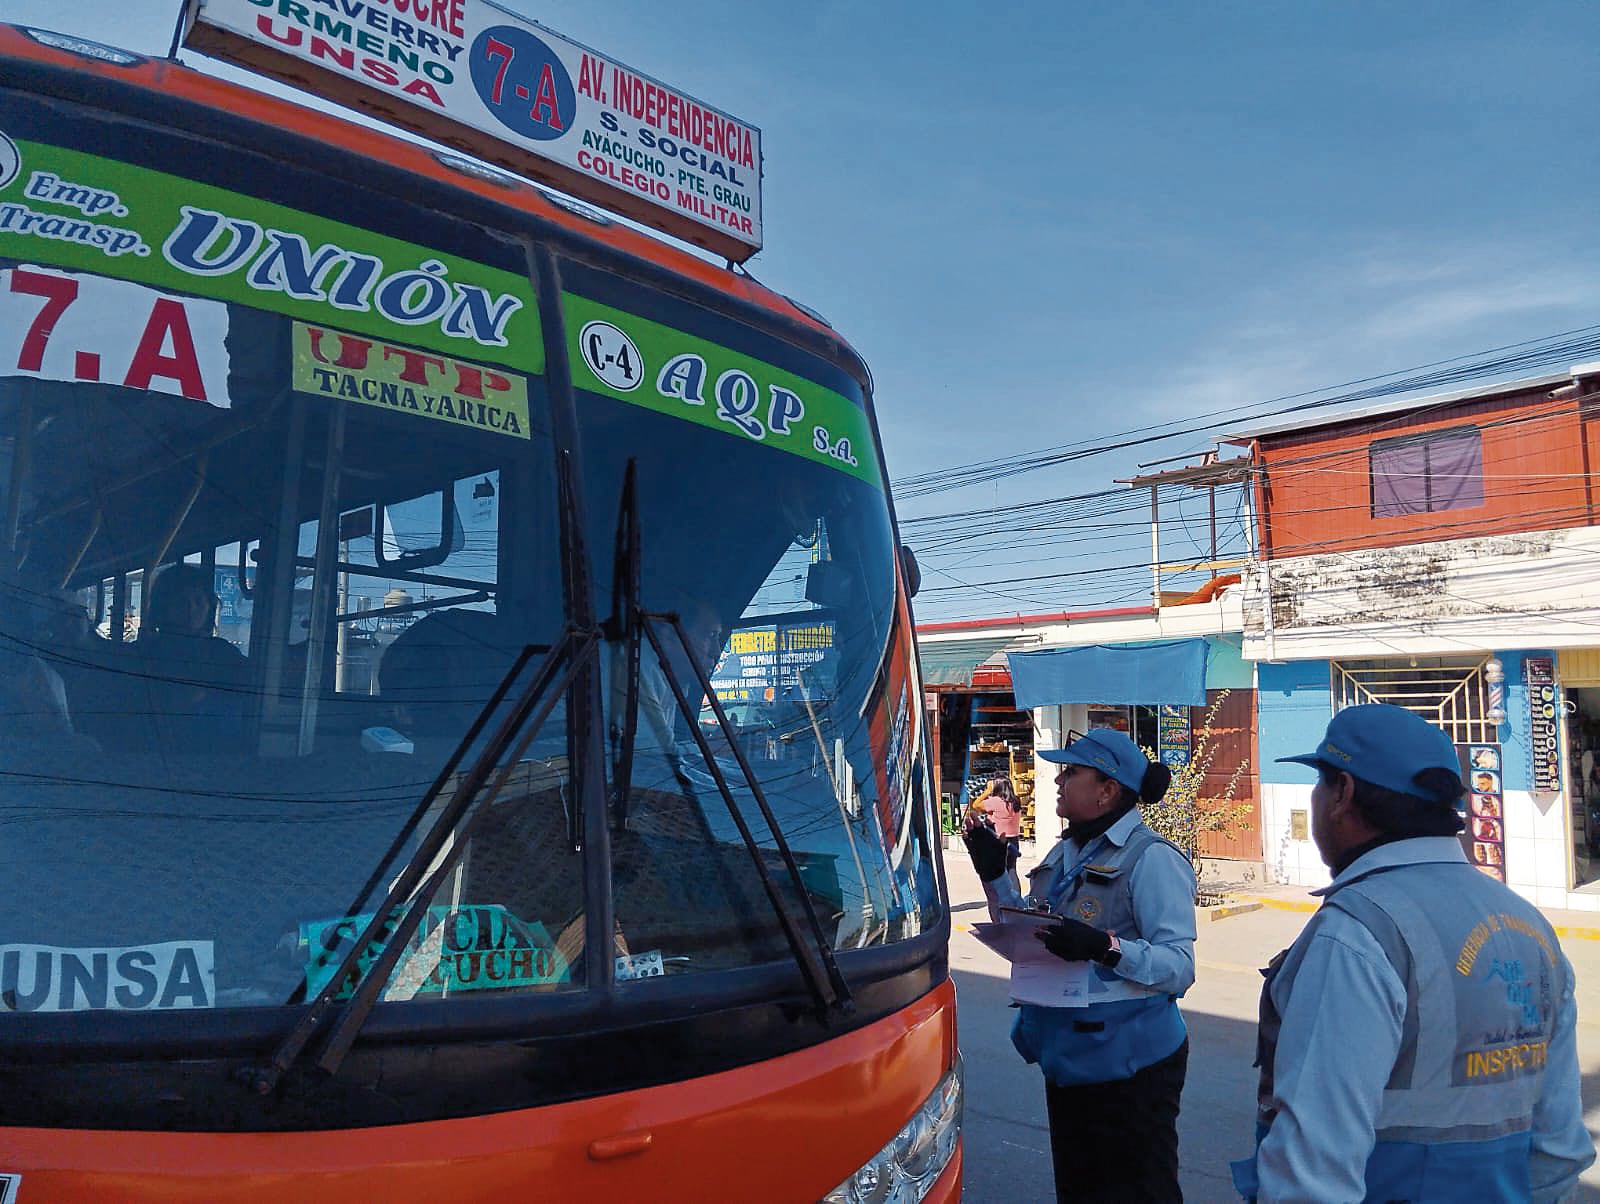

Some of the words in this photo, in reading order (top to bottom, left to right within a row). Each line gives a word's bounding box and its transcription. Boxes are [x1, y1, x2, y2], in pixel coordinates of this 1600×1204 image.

[377, 0, 465, 39] CRE
[256, 14, 446, 107] UNSA
[485, 36, 564, 132] 7-A
[578, 53, 607, 104] AV.
[613, 67, 754, 170] INDEPENDENCIA
[600, 111, 628, 137] S.
[638, 128, 744, 187] SOCIAL
[24, 171, 129, 217] Emp.
[577, 150, 671, 201] COLEGIO
[677, 190, 753, 236] MILITAR
[678, 168, 709, 197] PTE.
[713, 184, 751, 213] GRAU
[0, 202, 151, 256] Transp.
[162, 205, 523, 346] UNIÓN
[10, 269, 208, 401] 7.A
[307, 327, 512, 400] UTP
[589, 333, 634, 381] C-4
[656, 353, 806, 440] AQP
[813, 426, 858, 467] S.A.
[730, 631, 786, 655] FERRETERA
[2, 947, 209, 1012] UNSA
